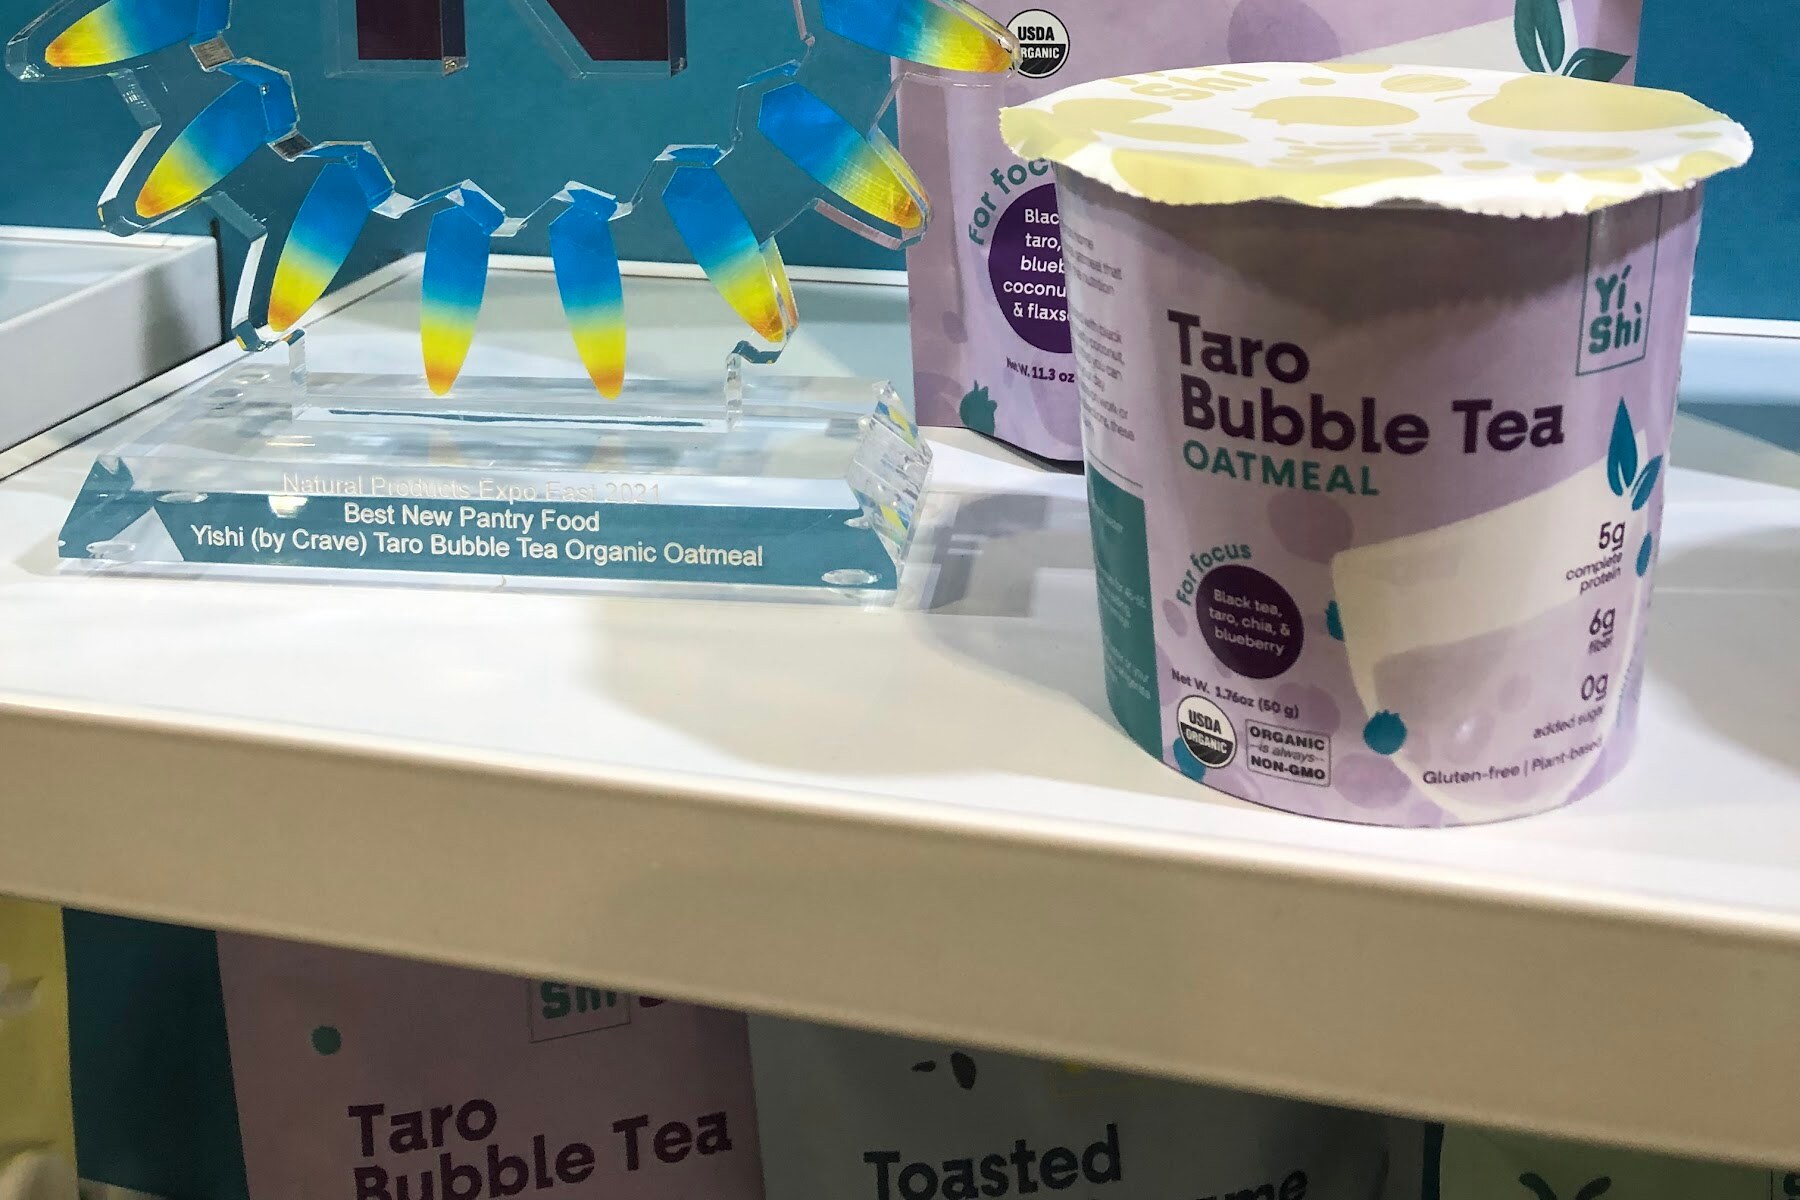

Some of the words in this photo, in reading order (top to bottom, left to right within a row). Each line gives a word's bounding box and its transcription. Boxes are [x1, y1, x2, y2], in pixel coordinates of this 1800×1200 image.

[1017, 26, 1055, 41] USDA
[1020, 47, 1060, 59] RGANIC
[968, 191, 997, 246] For
[1025, 233, 1062, 251] taro,
[1595, 264, 1632, 313] Yí
[1013, 302, 1024, 318] &
[1027, 302, 1069, 322] flaxs
[1588, 301, 1642, 354] Shì
[1167, 308, 1310, 384] Taro
[1031, 366, 1056, 381] 11.3
[1058, 371, 1075, 383] oz
[1180, 373, 1431, 456] Bubble
[1452, 398, 1566, 455] Tea
[1183, 439, 1381, 497] OATMEAL
[283, 472, 362, 496] Natural
[372, 475, 471, 499] Products
[479, 477, 537, 505] Expo
[545, 480, 596, 503] East
[604, 482, 663, 504] 2021
[344, 502, 395, 525] Best
[401, 504, 452, 527] New
[460, 506, 534, 534] Pantry
[541, 508, 600, 532] Food
[190, 524, 244, 547] Yishi
[251, 527, 285, 553] (by
[292, 528, 367, 556] Crave)
[373, 531, 423, 555] Taro
[430, 533, 510, 558] Bubble
[516, 537, 558, 560] Tea
[565, 538, 657, 566] Organic
[663, 542, 763, 567] Oatmeal
[1599, 521, 1626, 552] 5g
[1176, 569, 1196, 606] For
[1190, 544, 1252, 574] focus
[1214, 588, 1251, 609] Black
[1254, 600, 1282, 618] tea,
[1208, 607, 1239, 627] taro,
[1241, 616, 1277, 636] chia,
[1280, 623, 1291, 637] &
[1589, 608, 1616, 637] 6g
[1214, 626, 1286, 657] blueberry
[1171, 668, 1192, 687] Net
[1194, 678, 1210, 694] W.
[1215, 686, 1255, 707] 1.76oz
[1258, 697, 1281, 714] (50
[1284, 704, 1299, 720] g)
[1581, 673, 1608, 701] 0g
[1188, 709, 1222, 735] USDA
[1185, 726, 1228, 754] ORGANIC
[1250, 726, 1325, 751] ORGANIC
[1258, 740, 1269, 754] is
[1272, 744, 1315, 764] always
[1250, 755, 1326, 780] NON-GMO
[1422, 764, 1520, 784] Gluten-free
[348, 1099, 497, 1158] Taro
[353, 1134, 596, 1200] Bubble
[612, 1111, 733, 1172] Tea
[863, 1122, 1123, 1200] Toasted
